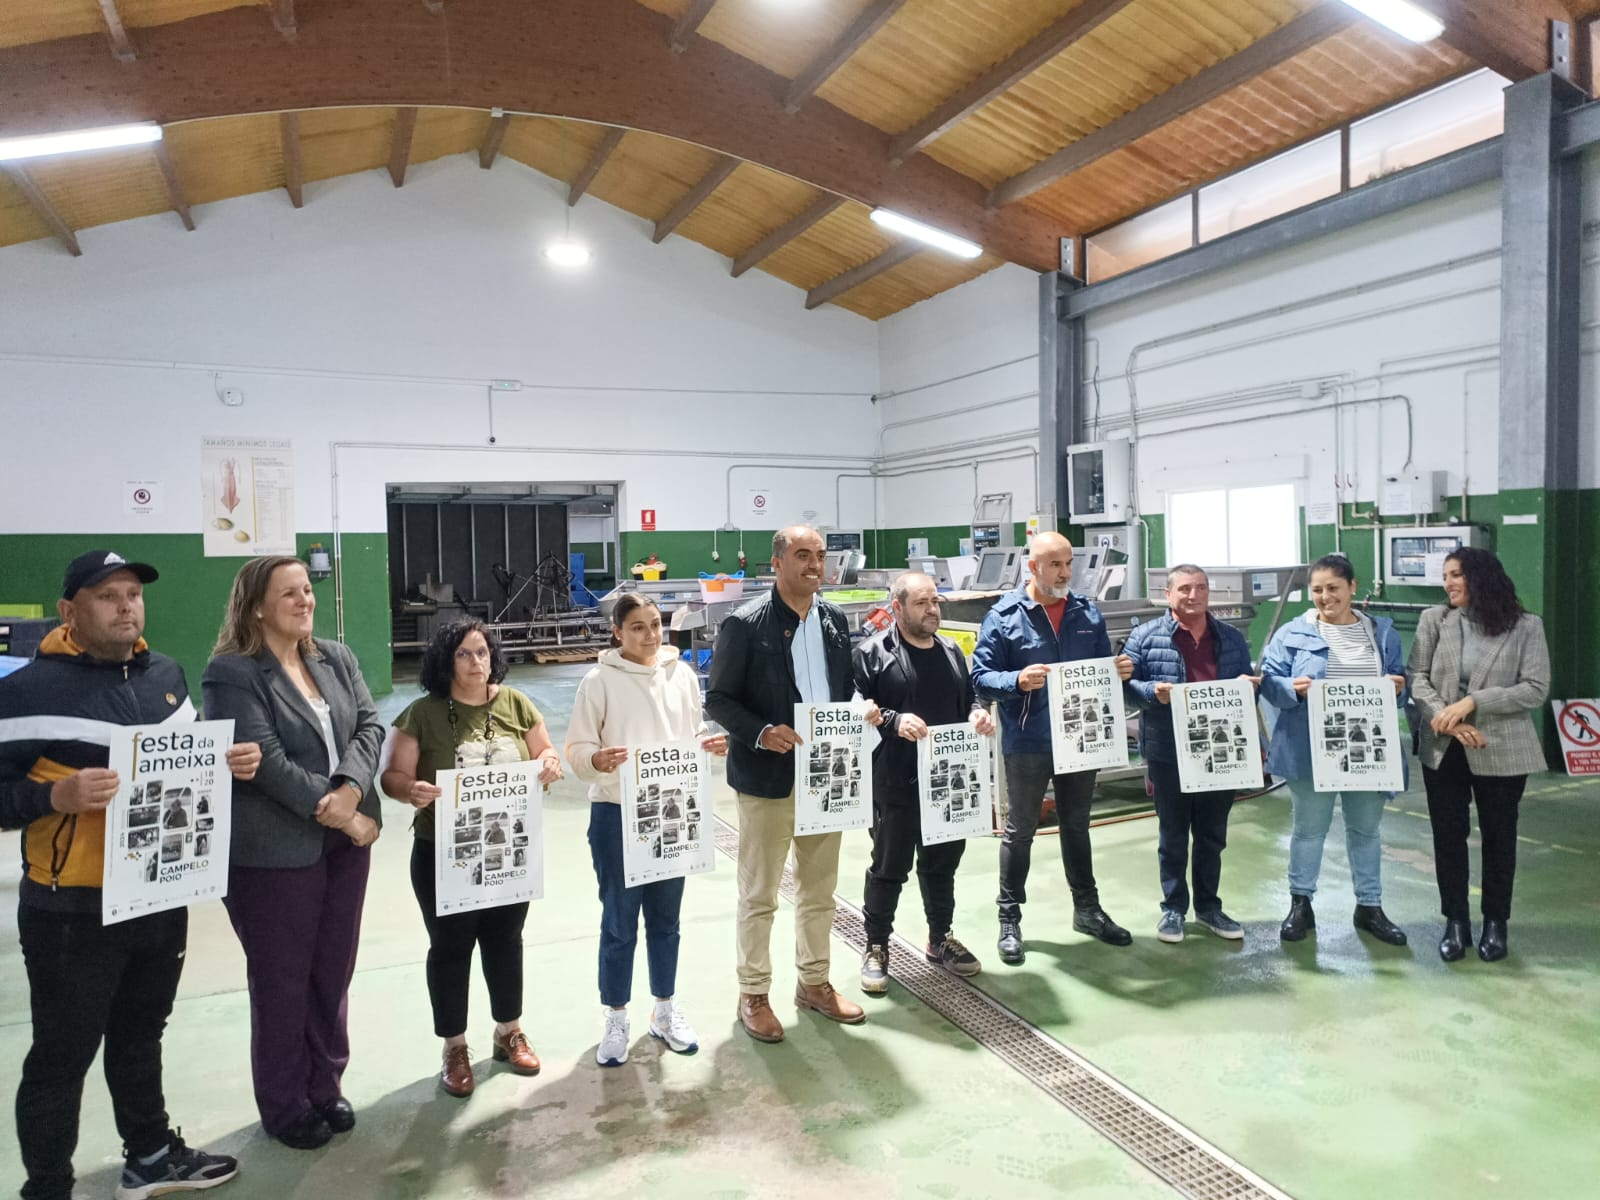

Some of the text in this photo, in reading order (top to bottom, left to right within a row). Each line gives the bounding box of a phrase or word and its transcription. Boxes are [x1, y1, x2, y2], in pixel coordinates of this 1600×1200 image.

[1064, 676, 1111, 690] ameixa
[1190, 697, 1243, 710] ameixa
[1328, 696, 1383, 707] ameixa
[853, 713, 863, 721] da
[815, 722, 863, 736] ameixa
[967, 732, 978, 740] da
[197, 737, 214, 749] da
[934, 741, 979, 756] ameixa
[683, 751, 696, 760] da
[138, 751, 216, 773] ameixa
[640, 762, 698, 779] ameixa
[511, 773, 527, 782] da
[460, 784, 528, 802] ameixa
[830, 800, 860, 808] CAMPELO
[951, 810, 980, 819] CAMPELO
[663, 843, 700, 853] CAMPELO
[663, 851, 680, 859] POIO
[160, 860, 209, 876] CAMPELO
[159, 873, 182, 884] POIO
[484, 869, 527, 881] CAMPELO
[484, 879, 504, 887] POIO
